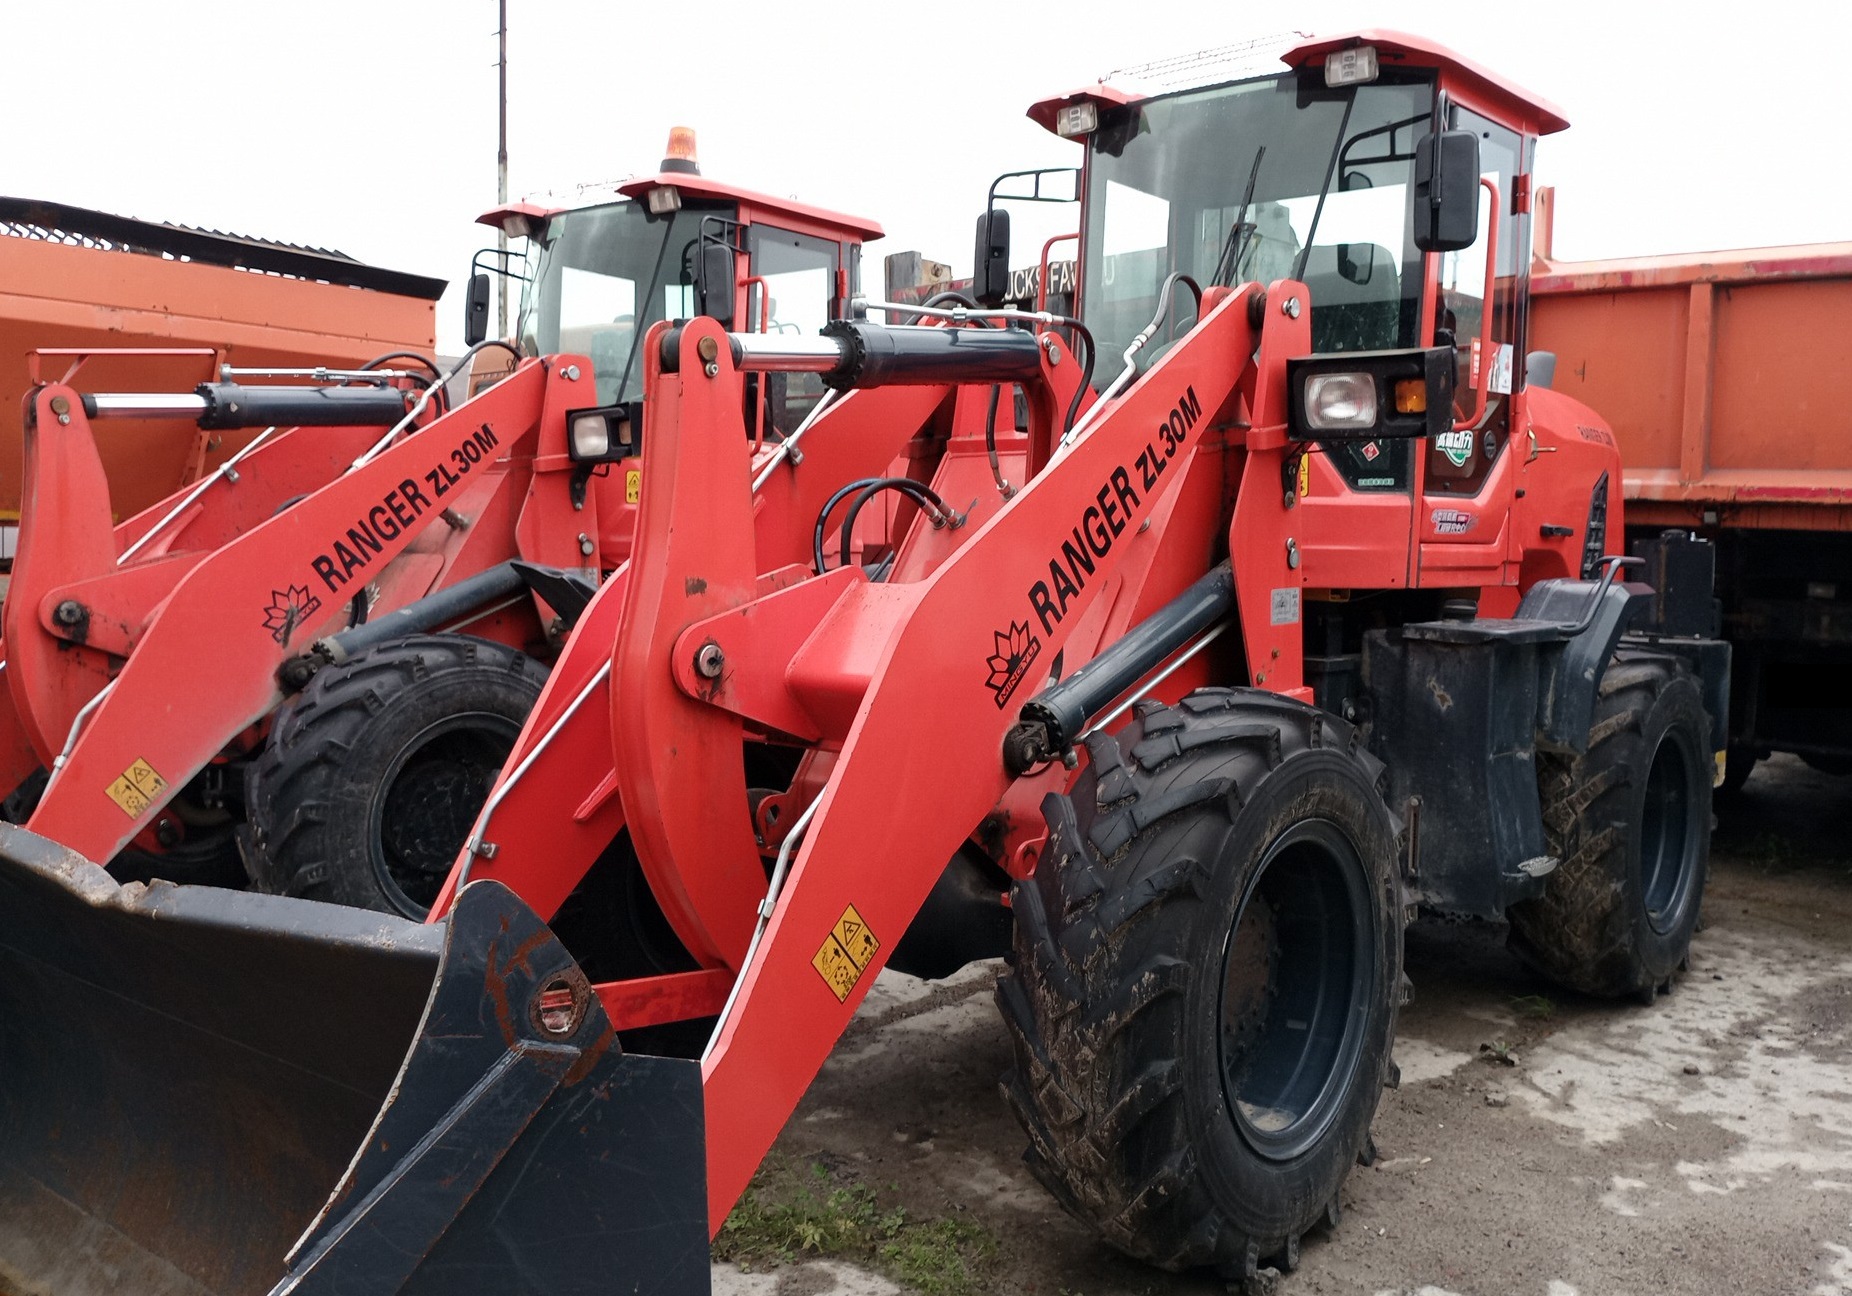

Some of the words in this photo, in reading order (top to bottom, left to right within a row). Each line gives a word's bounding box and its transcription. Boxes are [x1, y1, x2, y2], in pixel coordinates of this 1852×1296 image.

[311, 479, 432, 593] RANGER
[426, 423, 499, 497] ZL30M
[1028, 465, 1141, 637] RANGER
[1135, 385, 1203, 493] ZL30M
